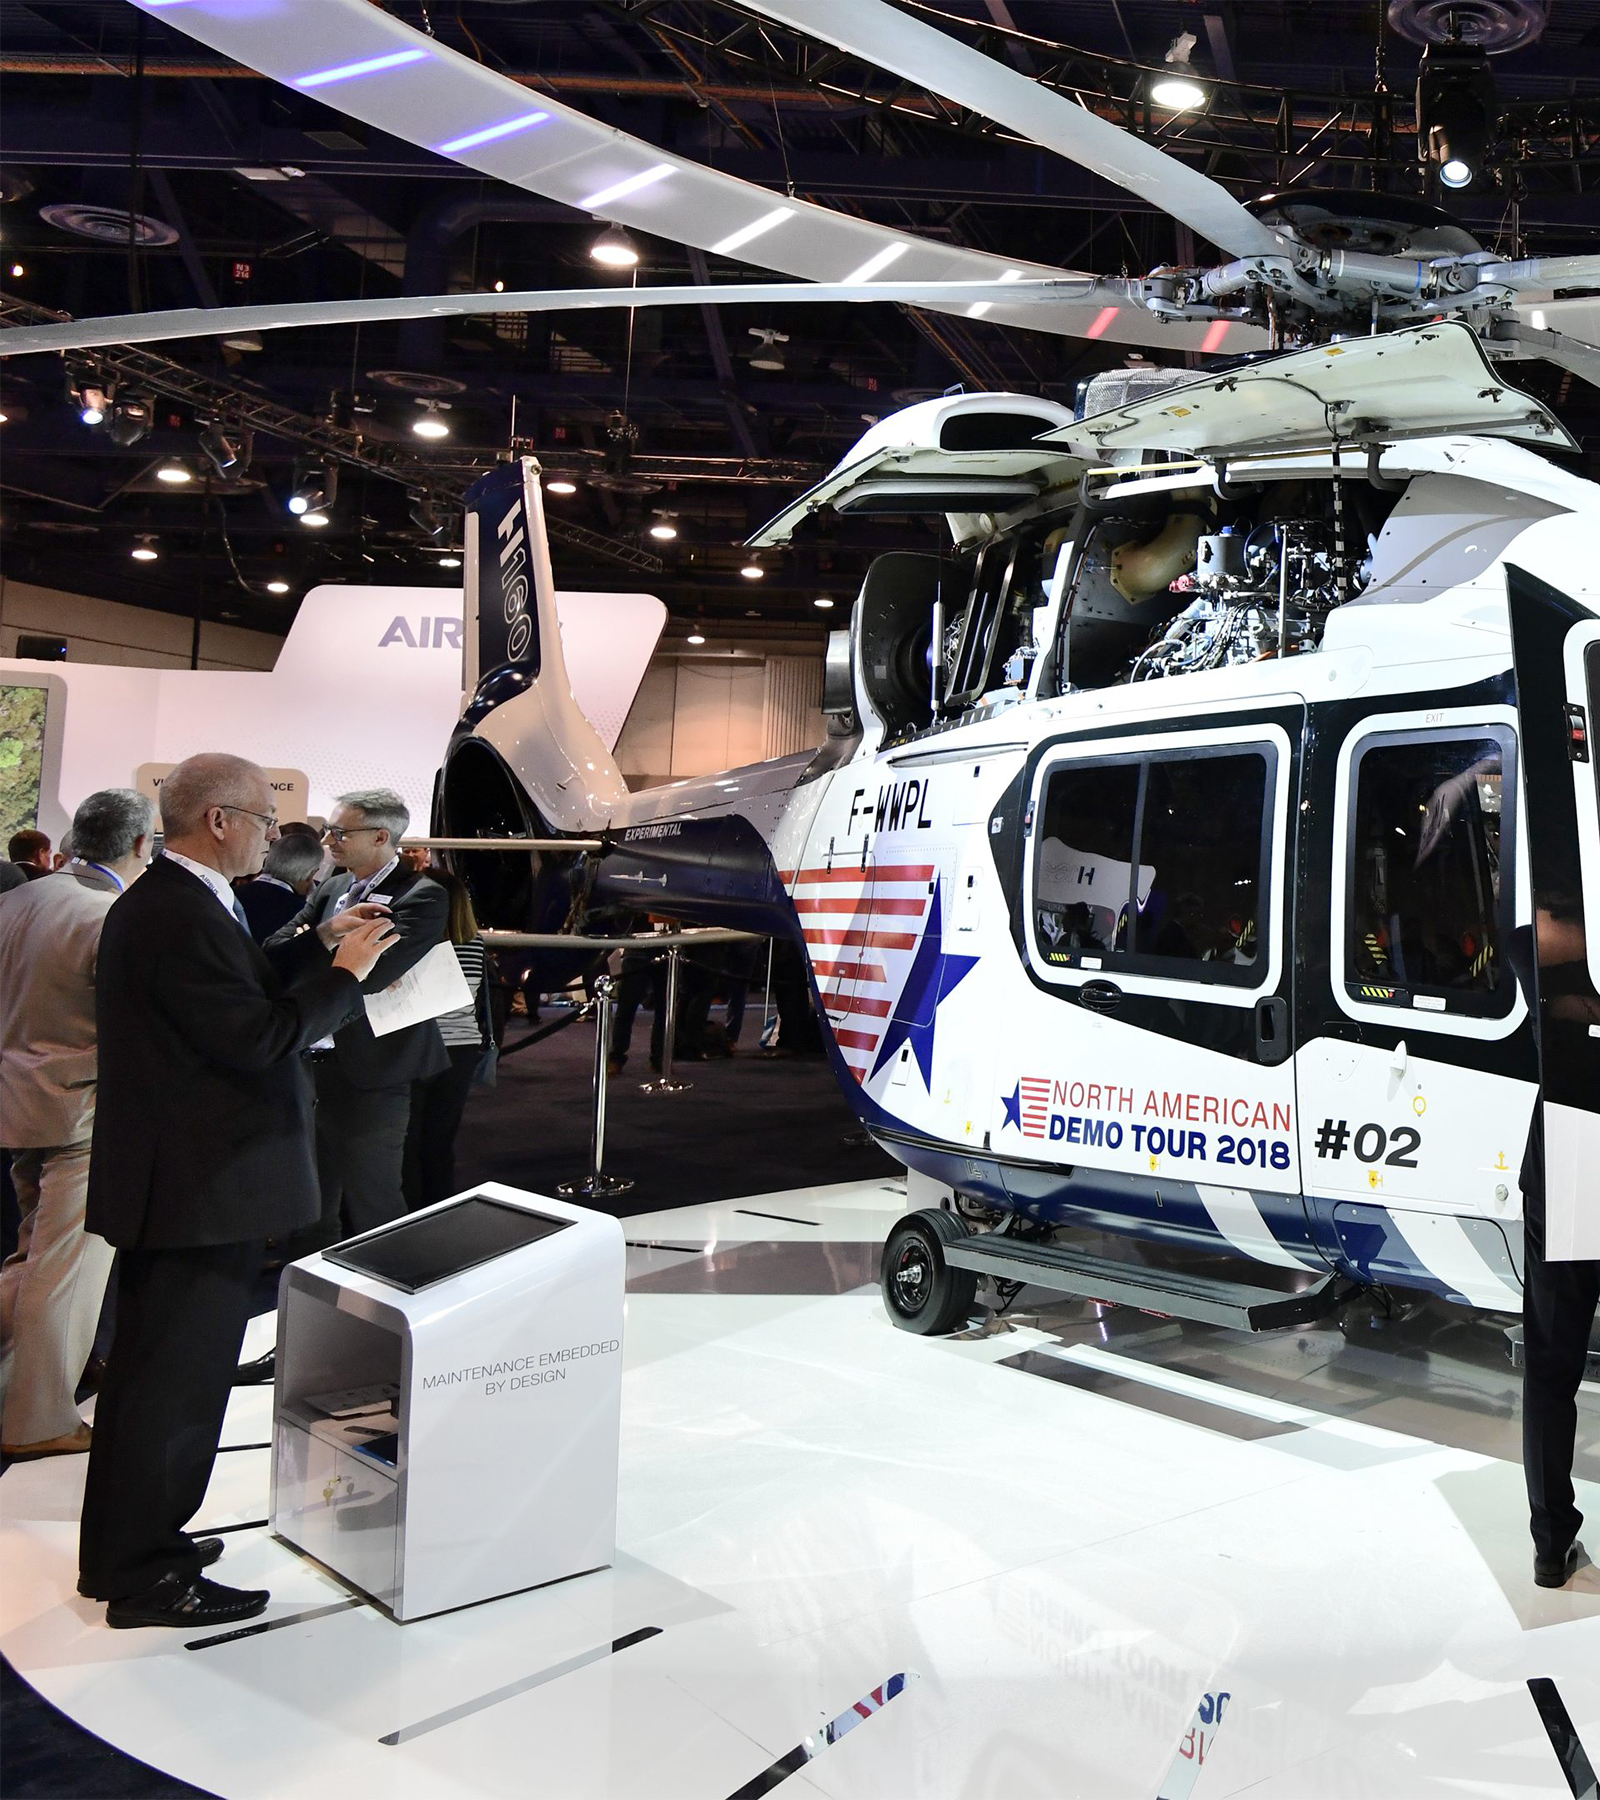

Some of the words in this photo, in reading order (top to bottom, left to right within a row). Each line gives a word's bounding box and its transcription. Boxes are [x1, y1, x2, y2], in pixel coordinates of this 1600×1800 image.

[236, 263, 250, 272] N3
[497, 499, 532, 662] H160
[1426, 713, 1444, 723] EXIT
[625, 823, 682, 841] EXPERIMENTAL
[847, 778, 931, 836] F-WWPL
[199, 874, 219, 896] AIRBUS
[1053, 1080, 1133, 1114] NORTH
[1143, 1090, 1291, 1132] AMERICAN
[1049, 1114, 1123, 1150] DEMO
[1131, 1125, 1206, 1160] TOUR
[1217, 1136, 1291, 1170] 2018
[1314, 1118, 1422, 1169] #02
[423, 1356, 535, 1389] MAINTENANCE
[539, 1339, 620, 1367] EMBEDDED
[485, 1380, 506, 1396] BY
[510, 1368, 566, 1391] DESIGN
